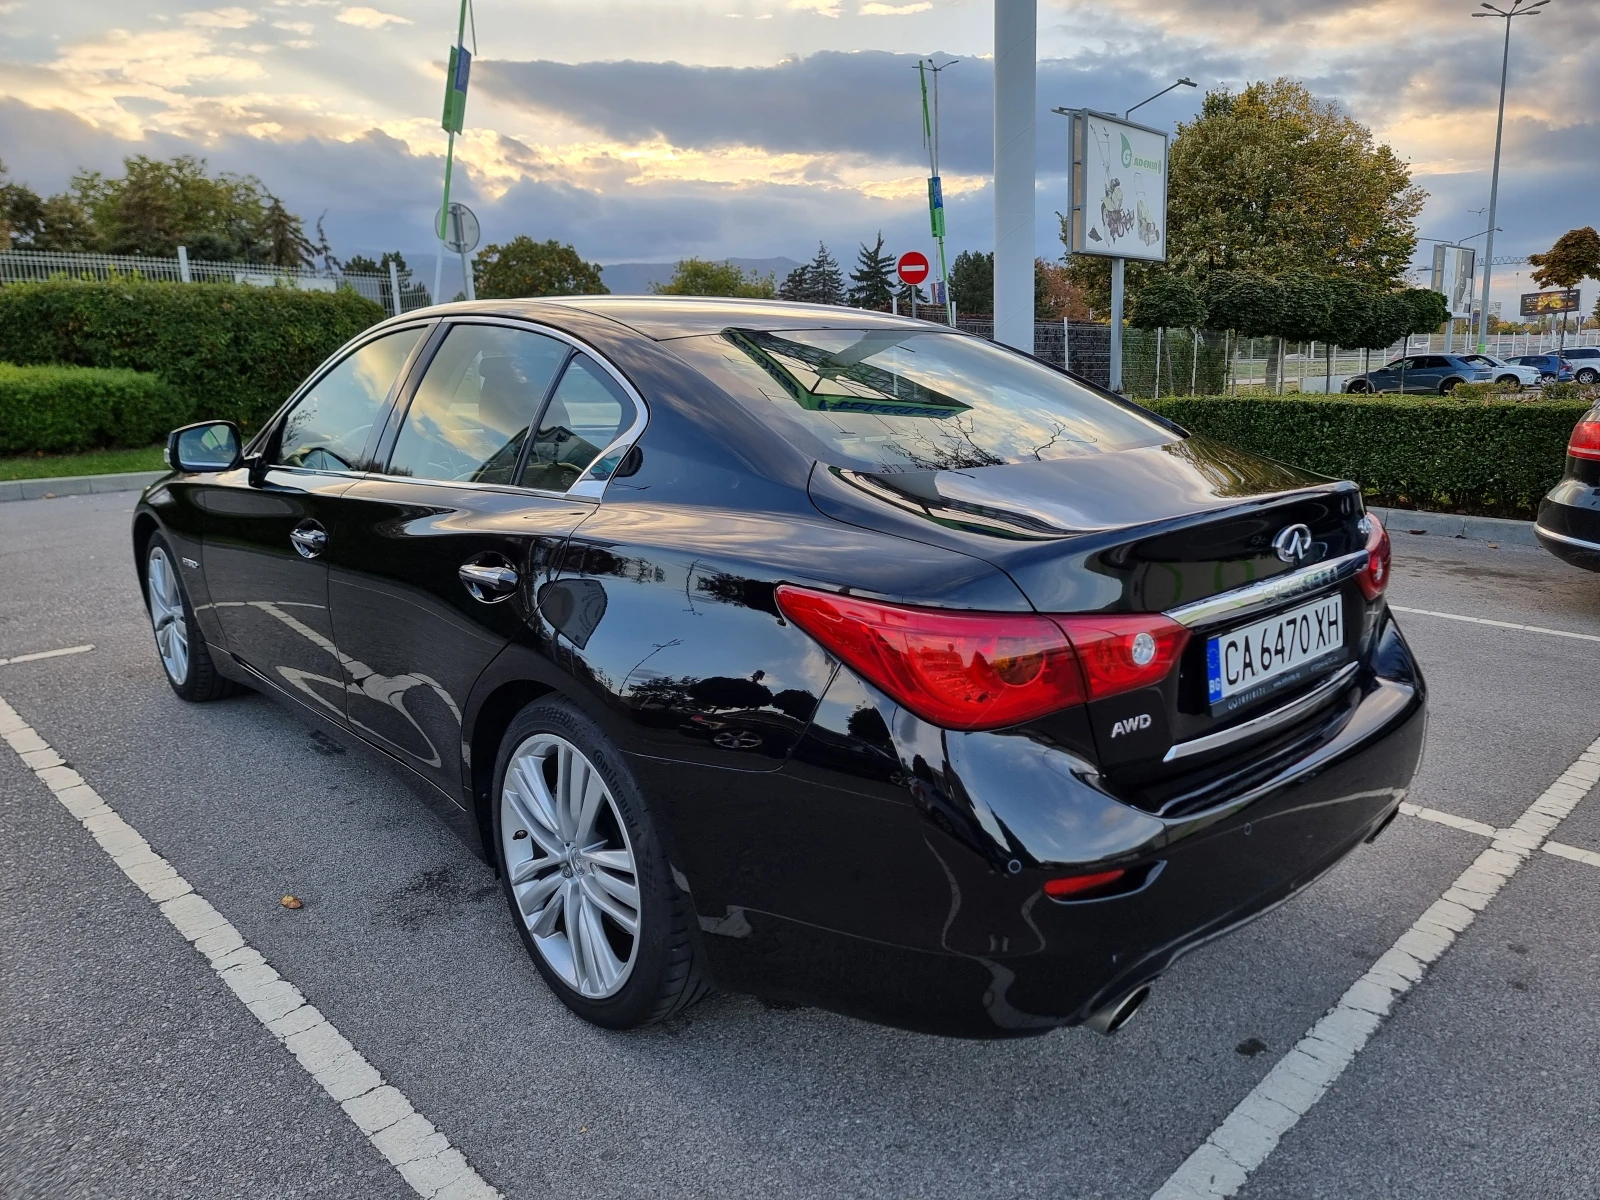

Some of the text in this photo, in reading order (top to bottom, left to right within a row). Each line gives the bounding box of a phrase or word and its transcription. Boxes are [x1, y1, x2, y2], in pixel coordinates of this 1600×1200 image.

[1224, 602, 1339, 686] CA 6470 XH
[1208, 676, 1222, 694] BG
[1110, 713, 1152, 739] AWD
[593, 748, 639, 828] Continental
